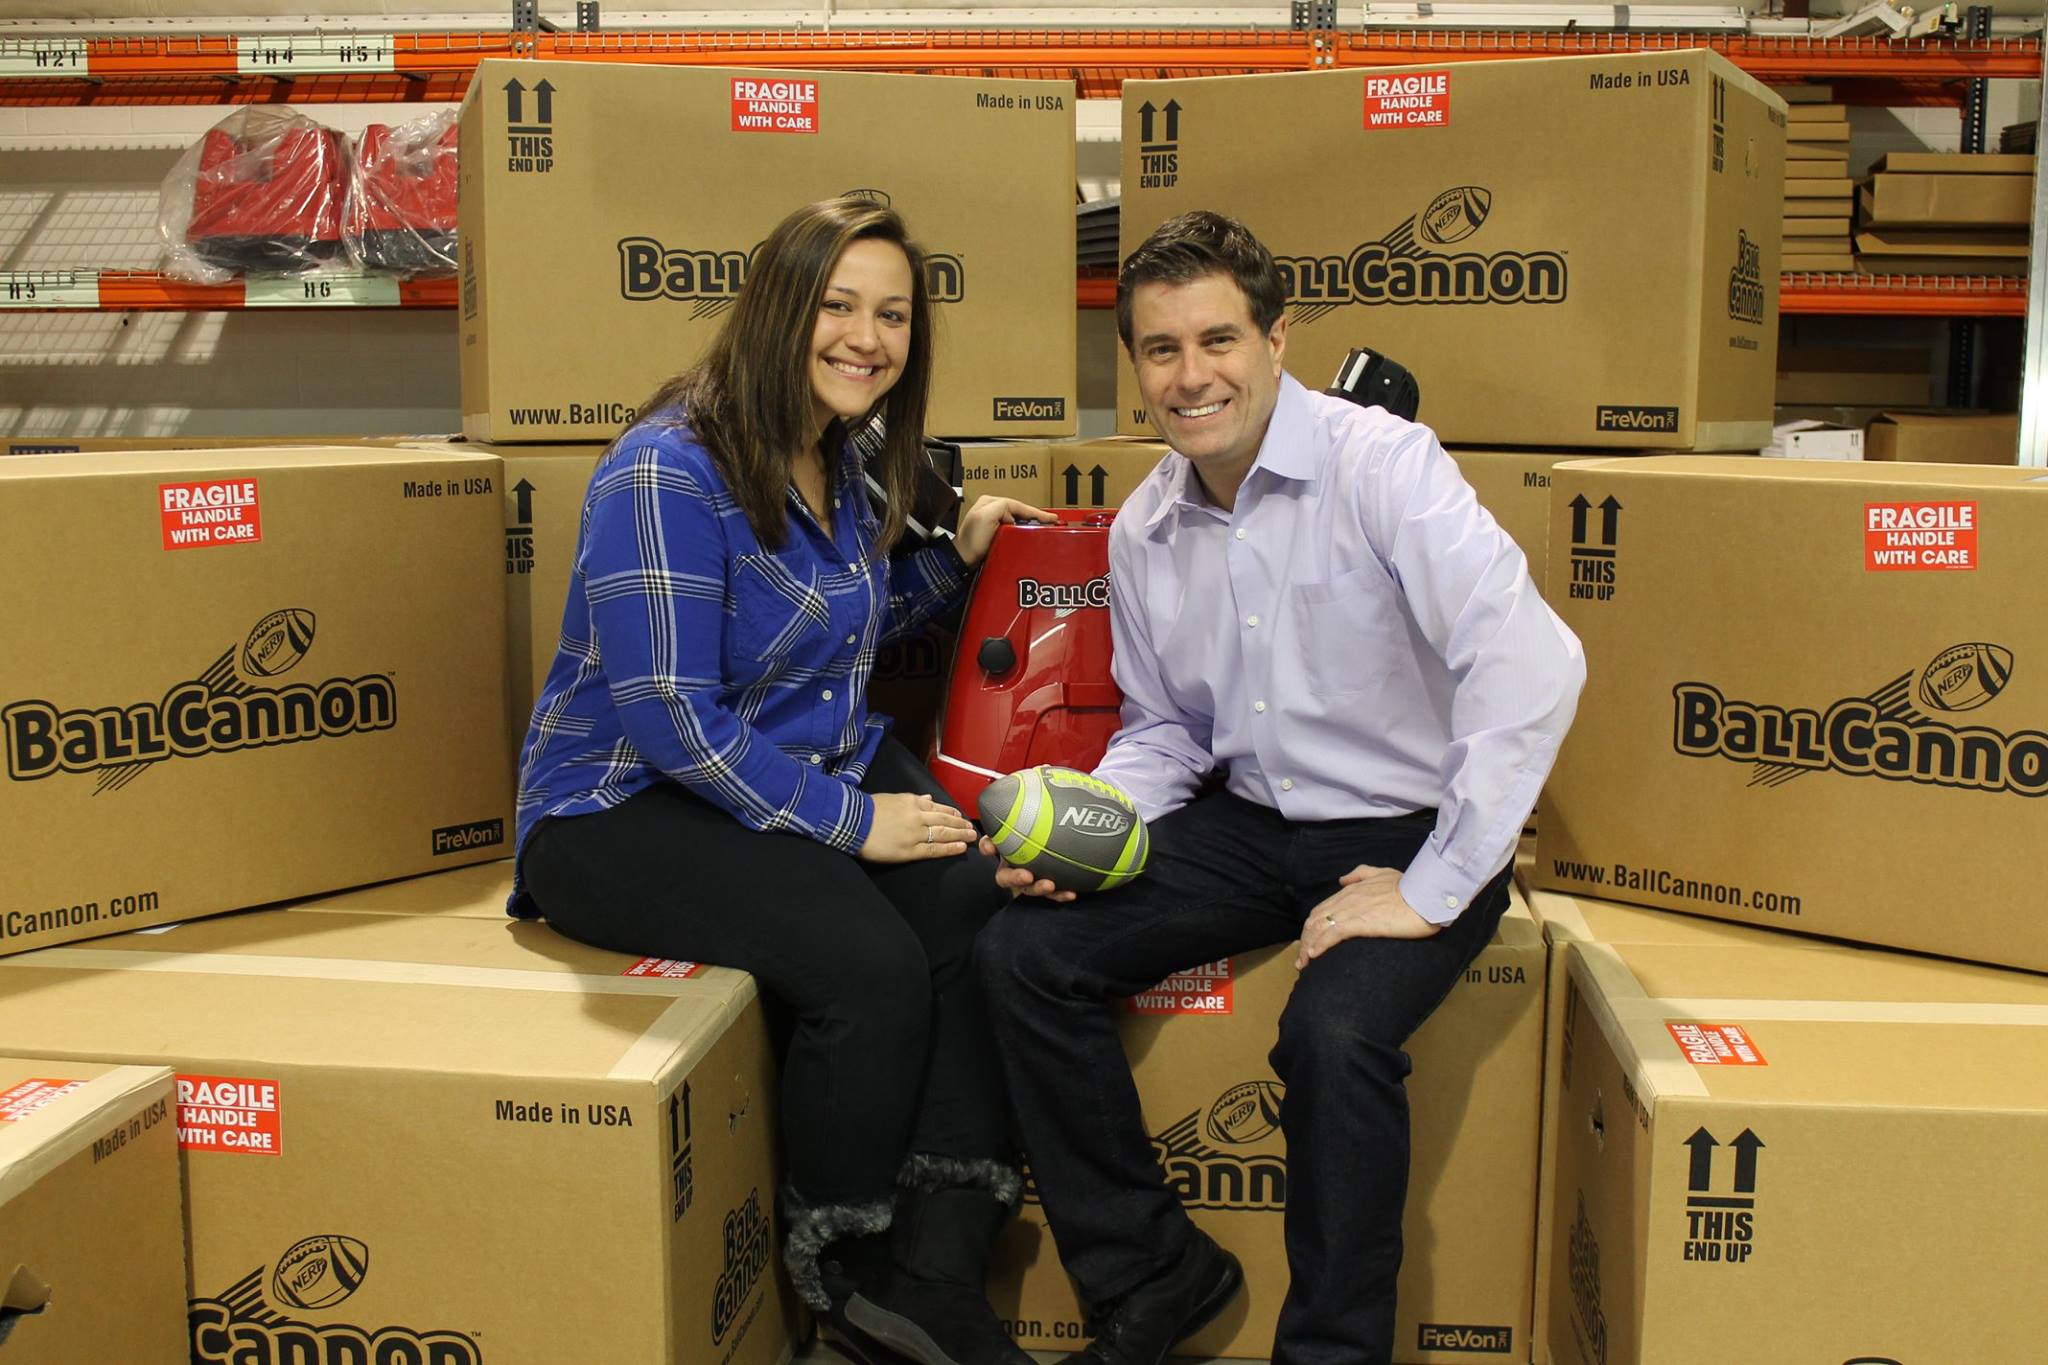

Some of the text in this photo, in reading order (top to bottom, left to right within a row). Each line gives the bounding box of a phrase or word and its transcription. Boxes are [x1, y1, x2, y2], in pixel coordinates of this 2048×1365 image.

[1367, 76, 1446, 96] FRAGILE
[1590, 69, 1690, 89] Made in USA
[735, 81, 815, 100] FRAGILE
[749, 101, 802, 114] HANDLE
[976, 93, 1064, 110] Made in USA
[1380, 96, 1432, 109] HANDLE
[739, 115, 812, 128] WITH CARE
[1370, 110, 1442, 125] WITH CARE
[508, 136, 553, 157] THIS
[508, 158, 553, 172] END UP
[1141, 154, 1178, 174] THIS
[1141, 174, 1178, 188] END UP
[509, 403, 637, 425] www.BallCa
[997, 401, 1053, 417] FreVon
[1600, 410, 1664, 428] FreVon
[963, 464, 1038, 480] ade in USA
[1524, 472, 1551, 488] Ma
[163, 484, 255, 509] FRAGILE
[403, 478, 493, 498] Made in USA
[182, 507, 242, 525] HANDLE
[1868, 506, 1972, 529] FRAGILE
[171, 524, 254, 544] WITH CARE
[1887, 532, 1955, 546] HANDLE
[1874, 549, 1969, 564] WITH CARE
[517, 560, 535, 574] UP
[1571, 559, 1615, 584] THIS
[1569, 583, 1615, 600] END UP
[1059, 806, 1129, 831] NERF
[436, 827, 492, 850] FreVon
[1553, 859, 1801, 916] www.BallCannon.com
[1466, 965, 1526, 984] in USA
[1135, 995, 1225, 1010] WITH CARE
[1672, 1024, 1717, 1063] FRAGILE
[1703, 1031, 1734, 1057] HANDLE
[177, 1080, 275, 1109] RAGILE
[184, 1108, 257, 1128] HANDLE
[496, 1100, 633, 1127] Made in USA
[93, 1098, 168, 1163] Made in USA
[221, 1130, 272, 1149] CARE
[1686, 1211, 1754, 1242] THIS
[1684, 1241, 1752, 1263] END UP
[1423, 1328, 1496, 1349] FreVon
